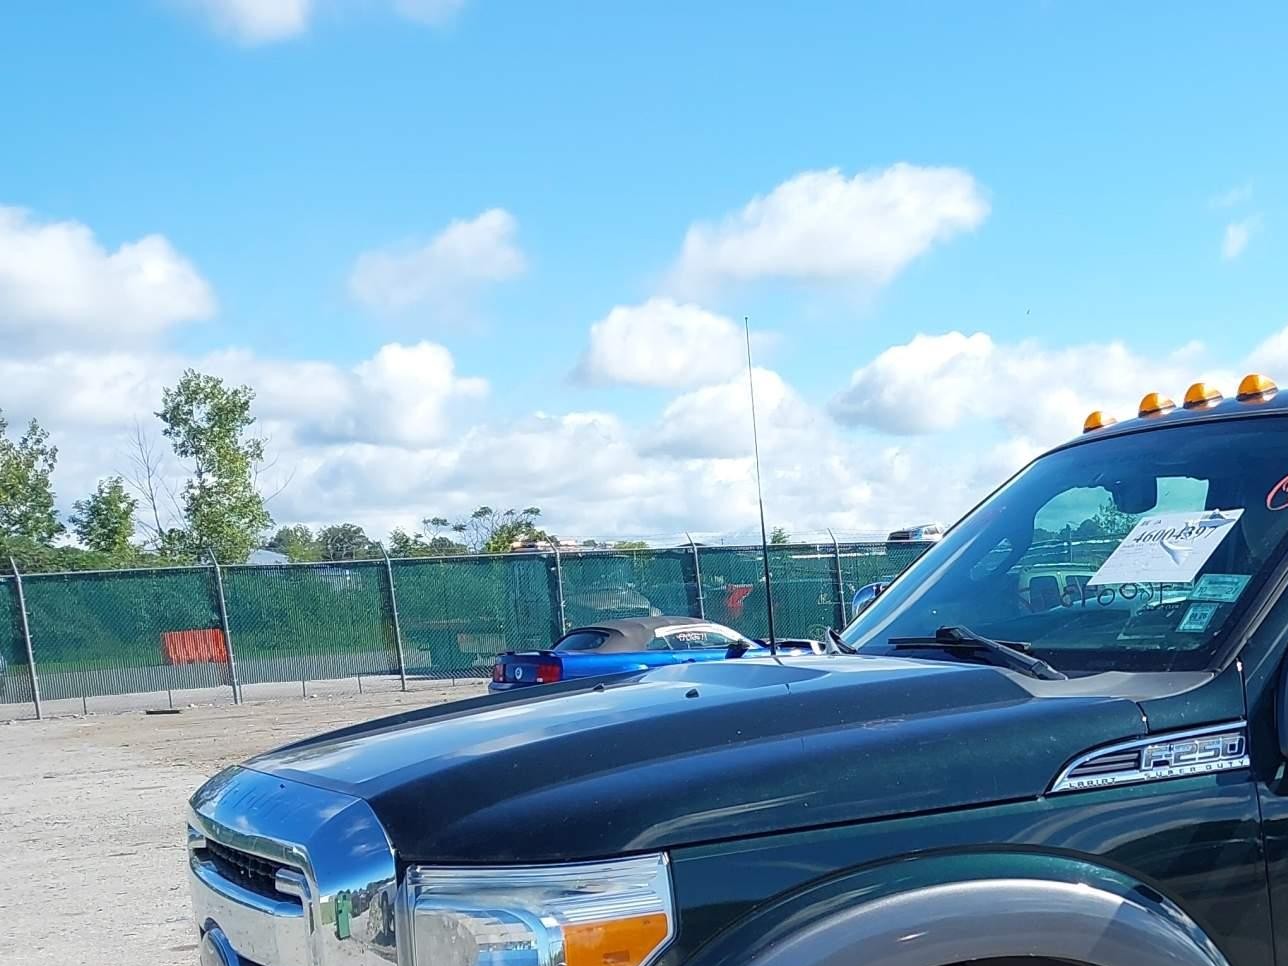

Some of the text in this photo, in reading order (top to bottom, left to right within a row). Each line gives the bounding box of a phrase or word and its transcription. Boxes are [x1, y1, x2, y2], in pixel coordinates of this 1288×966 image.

[1140, 735, 1247, 771] F-250
[1068, 777, 1117, 789] LARIAT
[1143, 766, 1197, 780] SUPER
